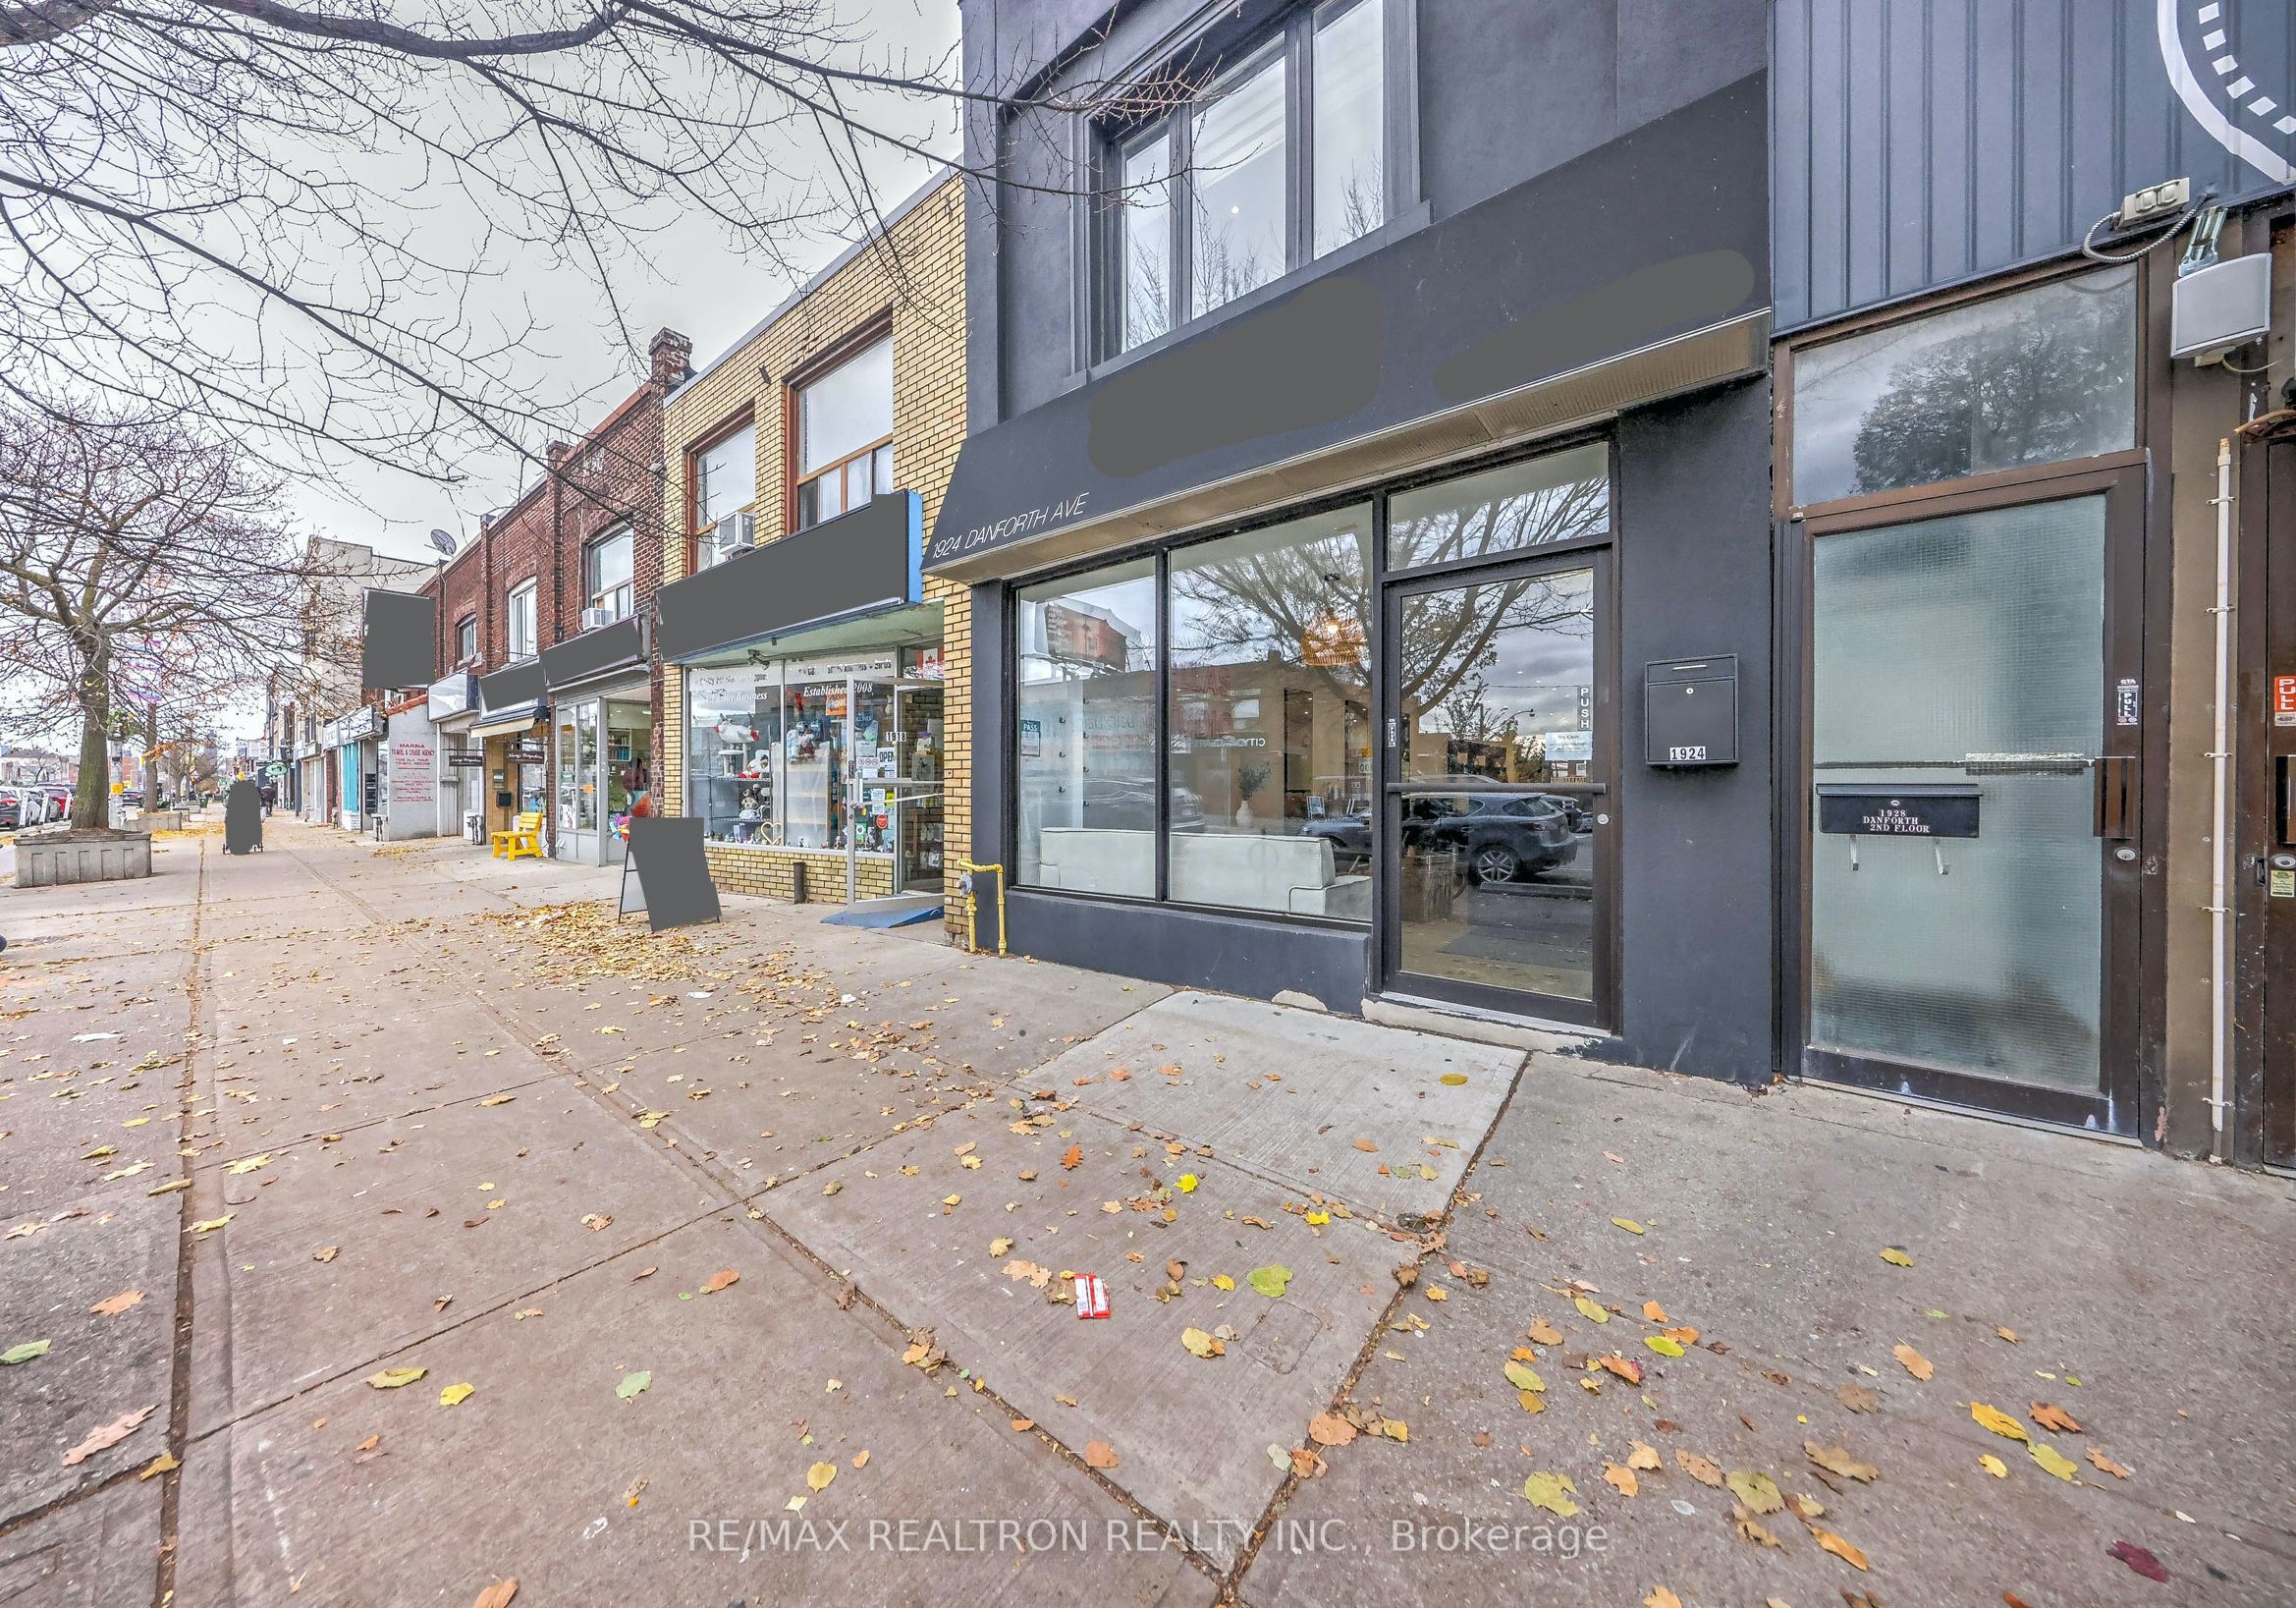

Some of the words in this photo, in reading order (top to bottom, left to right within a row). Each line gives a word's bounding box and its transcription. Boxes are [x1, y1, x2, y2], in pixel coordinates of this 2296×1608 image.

[933, 535, 961, 558] 1924
[964, 506, 1050, 550] DANFORTH
[1050, 492, 1090, 523] AVE
[2278, 678, 2296, 710] PULL
[1580, 688, 1590, 729] PUSH
[1022, 722, 1038, 733] PASS
[887, 732, 906, 742] 1918
[879, 751, 895, 763] OPEN
[1671, 748, 1705, 760] 1924
